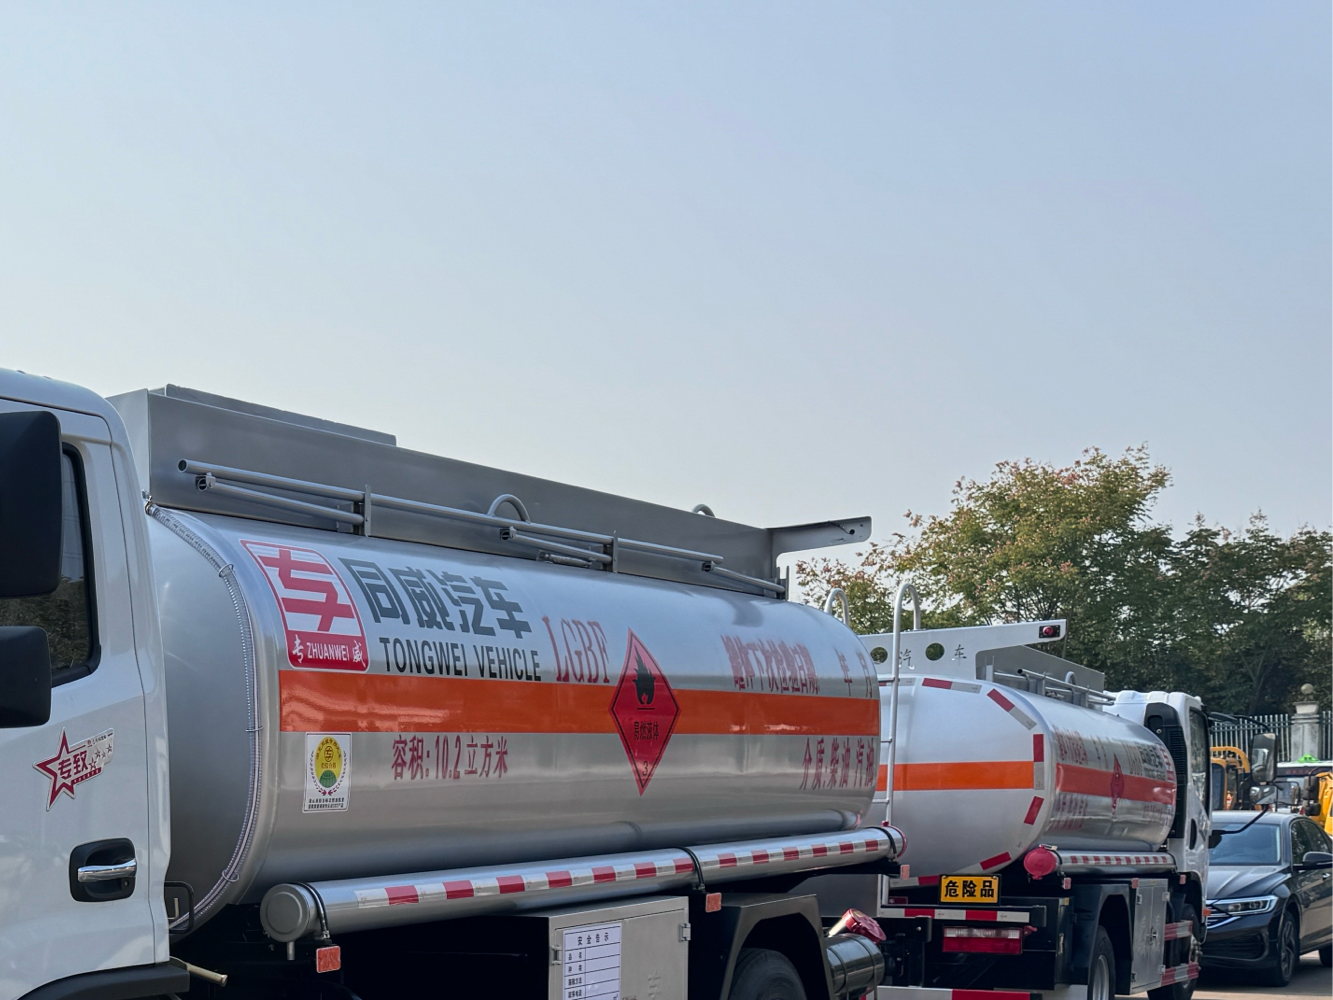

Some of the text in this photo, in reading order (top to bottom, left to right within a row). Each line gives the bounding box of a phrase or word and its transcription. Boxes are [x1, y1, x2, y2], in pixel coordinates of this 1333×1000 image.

[337, 557, 532, 640] 同威汽车
[307, 641, 350, 662] ZHUANWEI
[379, 637, 542, 682] TONGWEI VEHICLE
[391, 734, 508, 780] 容积:10.2立方米
[642, 760, 649, 777] 3
[945, 880, 994, 898] 危险品
